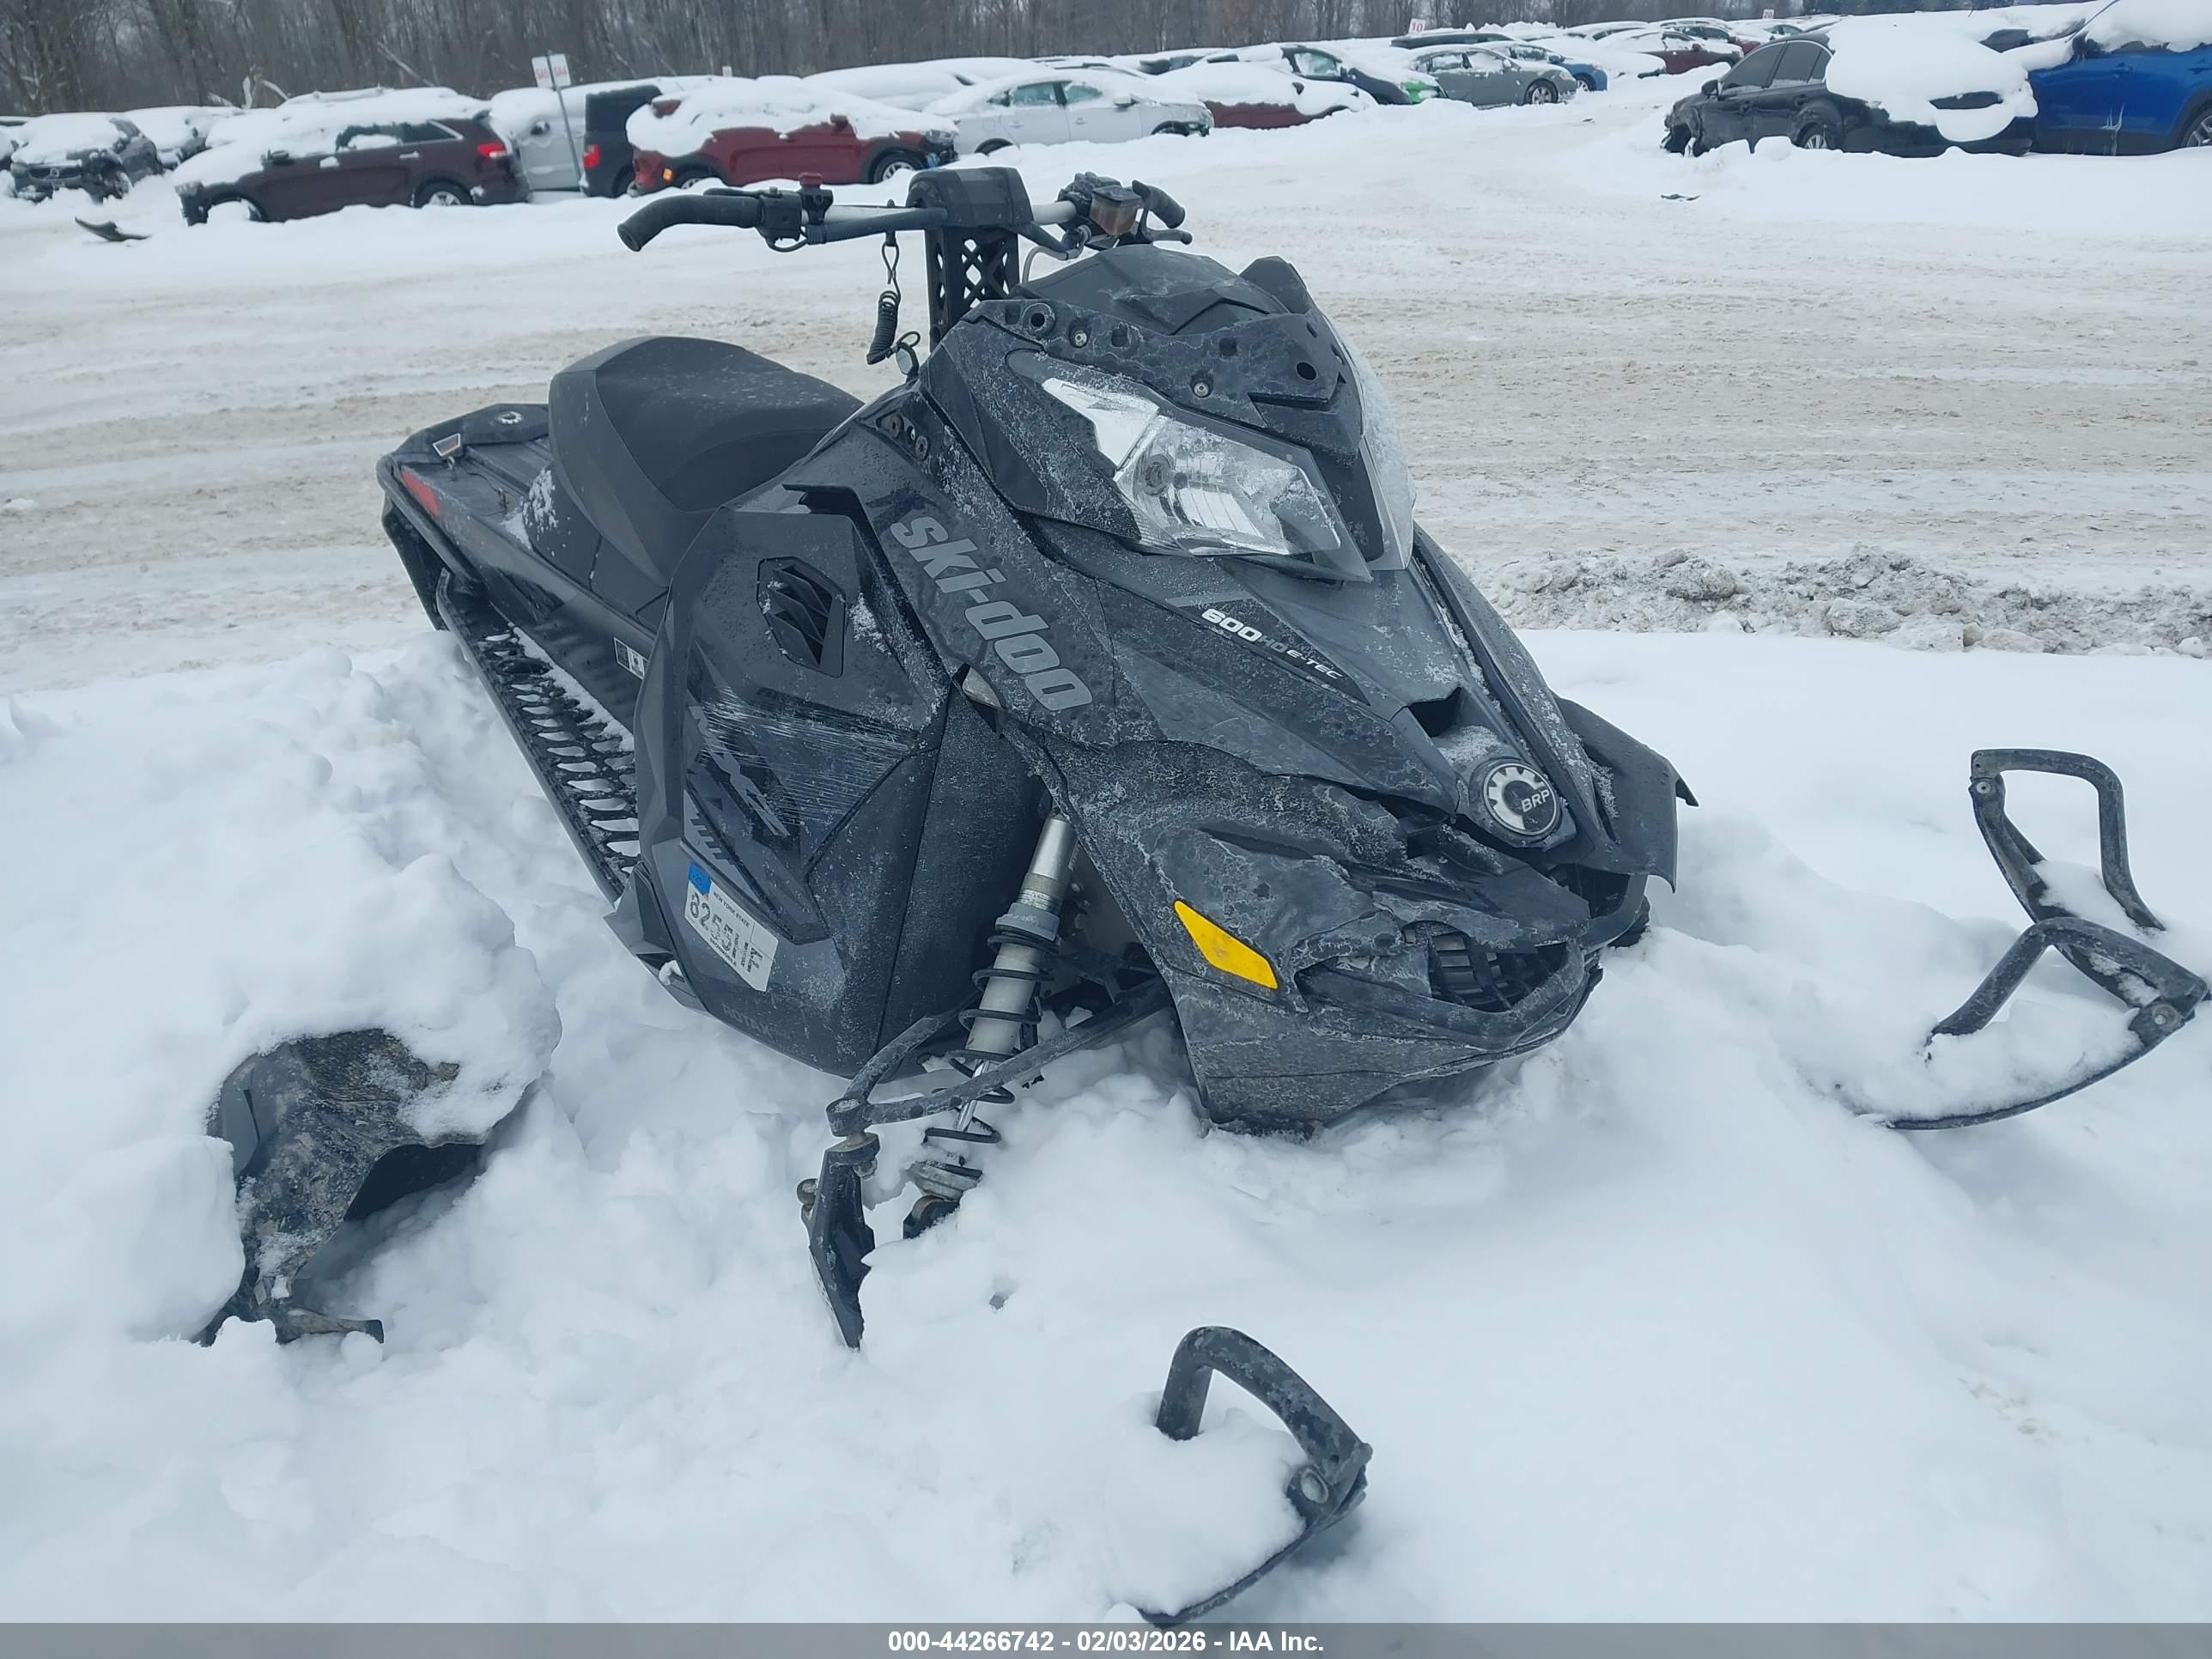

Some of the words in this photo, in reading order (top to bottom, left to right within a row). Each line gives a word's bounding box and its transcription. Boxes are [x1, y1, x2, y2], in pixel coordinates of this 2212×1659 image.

[1412, 22, 1424, 33] 10
[890, 516, 1093, 712] ski-doo
[1201, 608, 1263, 642] 600
[1286, 649, 1344, 679] E-TEC
[1521, 789, 1550, 812] BRP
[713, 890, 723, 903] NEW
[723, 900, 736, 916] YORK
[735, 913, 750, 928] STATE
